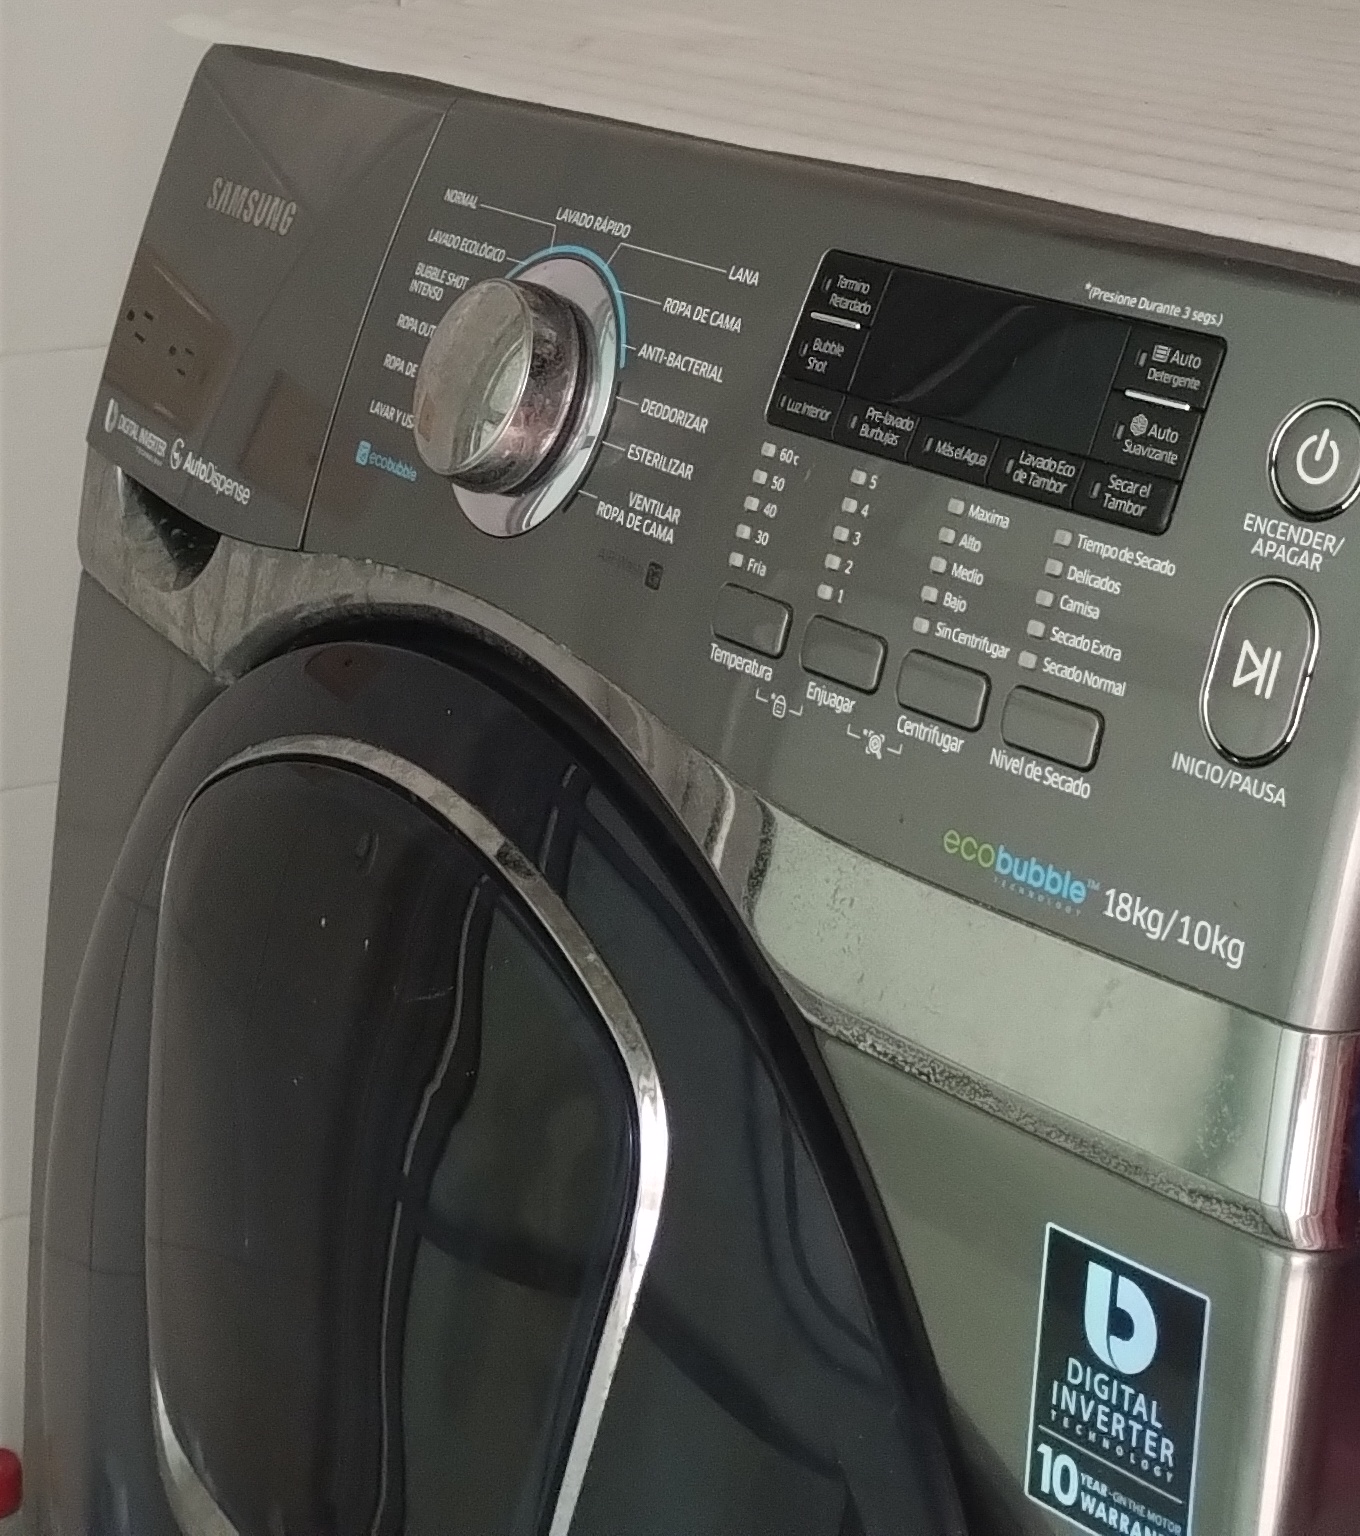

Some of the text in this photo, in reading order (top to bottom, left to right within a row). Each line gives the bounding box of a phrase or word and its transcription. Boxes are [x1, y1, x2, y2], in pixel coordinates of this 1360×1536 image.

[206, 176, 297, 236] SAMSUNG
[443, 188, 479, 210] NORMAL
[555, 206, 632, 239] LAVADO RÁPIDO
[427, 228, 506, 262] LAVADO ECOLÓGICO
[409, 279, 444, 301] INTENSO
[414, 262, 470, 290] BUBBLE SHOT
[728, 265, 760, 287] LANA
[663, 297, 742, 334] ROPA DE CAMA
[829, 292, 872, 315] Retardado
[1137, 296, 1181, 317] Durante
[1181, 306, 1191, 319] 3
[396, 313, 437, 339] ROPA OUT
[812, 337, 845, 358] Bubble
[1170, 349, 1202, 369] Auto
[383, 353, 419, 378] ROPA DE
[637, 343, 724, 383] ANTI-BACTERIAL
[805, 356, 829, 375] Shot
[1146, 367, 1201, 391] Detergente
[369, 399, 415, 429] LAVAR Y US
[640, 398, 709, 434] DEODORIZAR
[786, 398, 833, 422] Luz Interior
[865, 406, 915, 432] Pre-lavado
[859, 423, 900, 446] Burbujas
[1147, 423, 1179, 444] Auto
[627, 444, 694, 480] ESTERILIZAR
[963, 448, 988, 466] Agua
[1018, 449, 1076, 478] Lavado Eco
[1122, 438, 1178, 465] Suavizante
[182, 450, 251, 505] AutoDispense
[369, 451, 418, 482] ecobubble
[770, 475, 786, 492] 50
[868, 474, 879, 490] 5
[1012, 468, 1068, 495] de Tambor
[1107, 473, 1153, 499] Secar el
[628, 491, 681, 525] VENTILAR
[763, 502, 778, 518] 40
[860, 503, 870, 518] 4
[1102, 493, 1148, 517] Tambor
[596, 500, 675, 544] ROPA DE CAMA
[1243, 512, 1346, 557] ENCENDER/
[754, 529, 769, 546] 30
[852, 531, 862, 547] 3
[958, 533, 983, 553] Alto
[844, 559, 854, 575] 2
[1076, 533, 1177, 577] Tiempo de Secado
[1251, 537, 1324, 572] APAGAR
[950, 561, 985, 587] Medio
[1066, 565, 1122, 595] Delicados
[837, 589, 845, 603] 1
[942, 590, 968, 613] Bajo
[1058, 594, 1101, 620] Camisa
[934, 621, 1011, 660] Sin Centrifugar
[1049, 625, 1122, 663] Secado Extra
[709, 642, 774, 683] Temperatura
[1042, 656, 1127, 697] Secado Normal
[806, 680, 857, 714] Enjuagar
[896, 714, 965, 754] Centrifugar
[989, 746, 1091, 799] Nivel de Secado
[1171, 751, 1287, 808] INICIO/PAUSA
[943, 829, 1087, 904] ecobubble
[1101, 888, 1246, 969] 18kg/10kg
[1067, 1357, 1163, 1429] DIGITAL
[1052, 1380, 1175, 1467] INVERTER
[1051, 1409, 1174, 1483] TECHNOLOGY
[1037, 1443, 1079, 1506] 10
[1080, 1472, 1108, 1497] YEAR
[1146, 1509, 1182, 1535] MOTOR
[1080, 1491, 1165, 1536] WARRA
